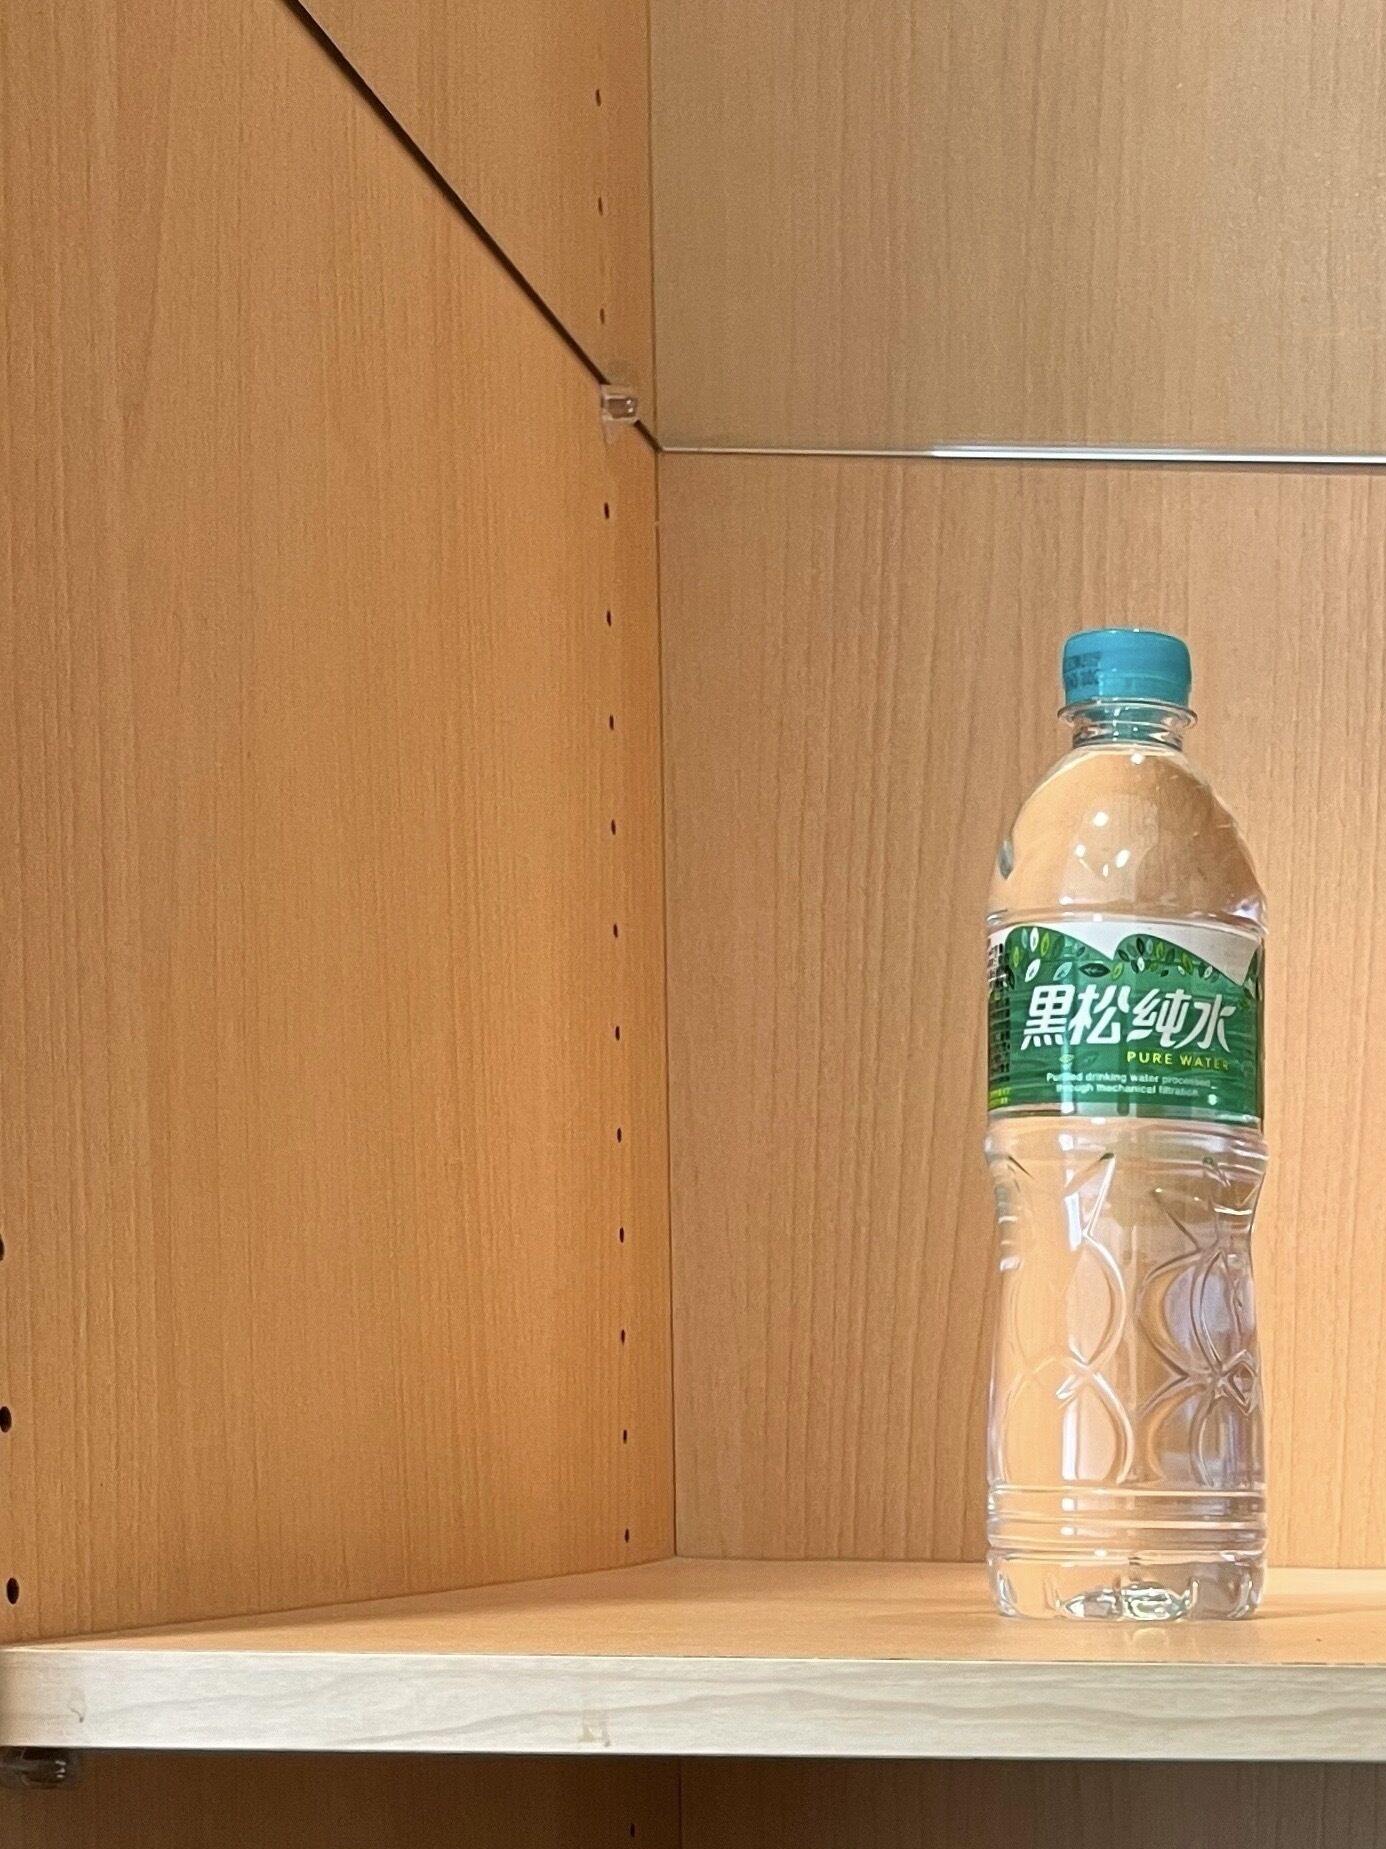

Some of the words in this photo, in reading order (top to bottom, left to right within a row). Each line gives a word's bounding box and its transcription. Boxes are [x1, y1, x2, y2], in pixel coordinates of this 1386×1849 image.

[1126, 1051, 1173, 1065] PURE
[1179, 1055, 1230, 1071] WATER
[1085, 1072, 1127, 1083] drinking
[1130, 1073, 1159, 1083] water
[1096, 1083, 1156, 1095] mechanical
